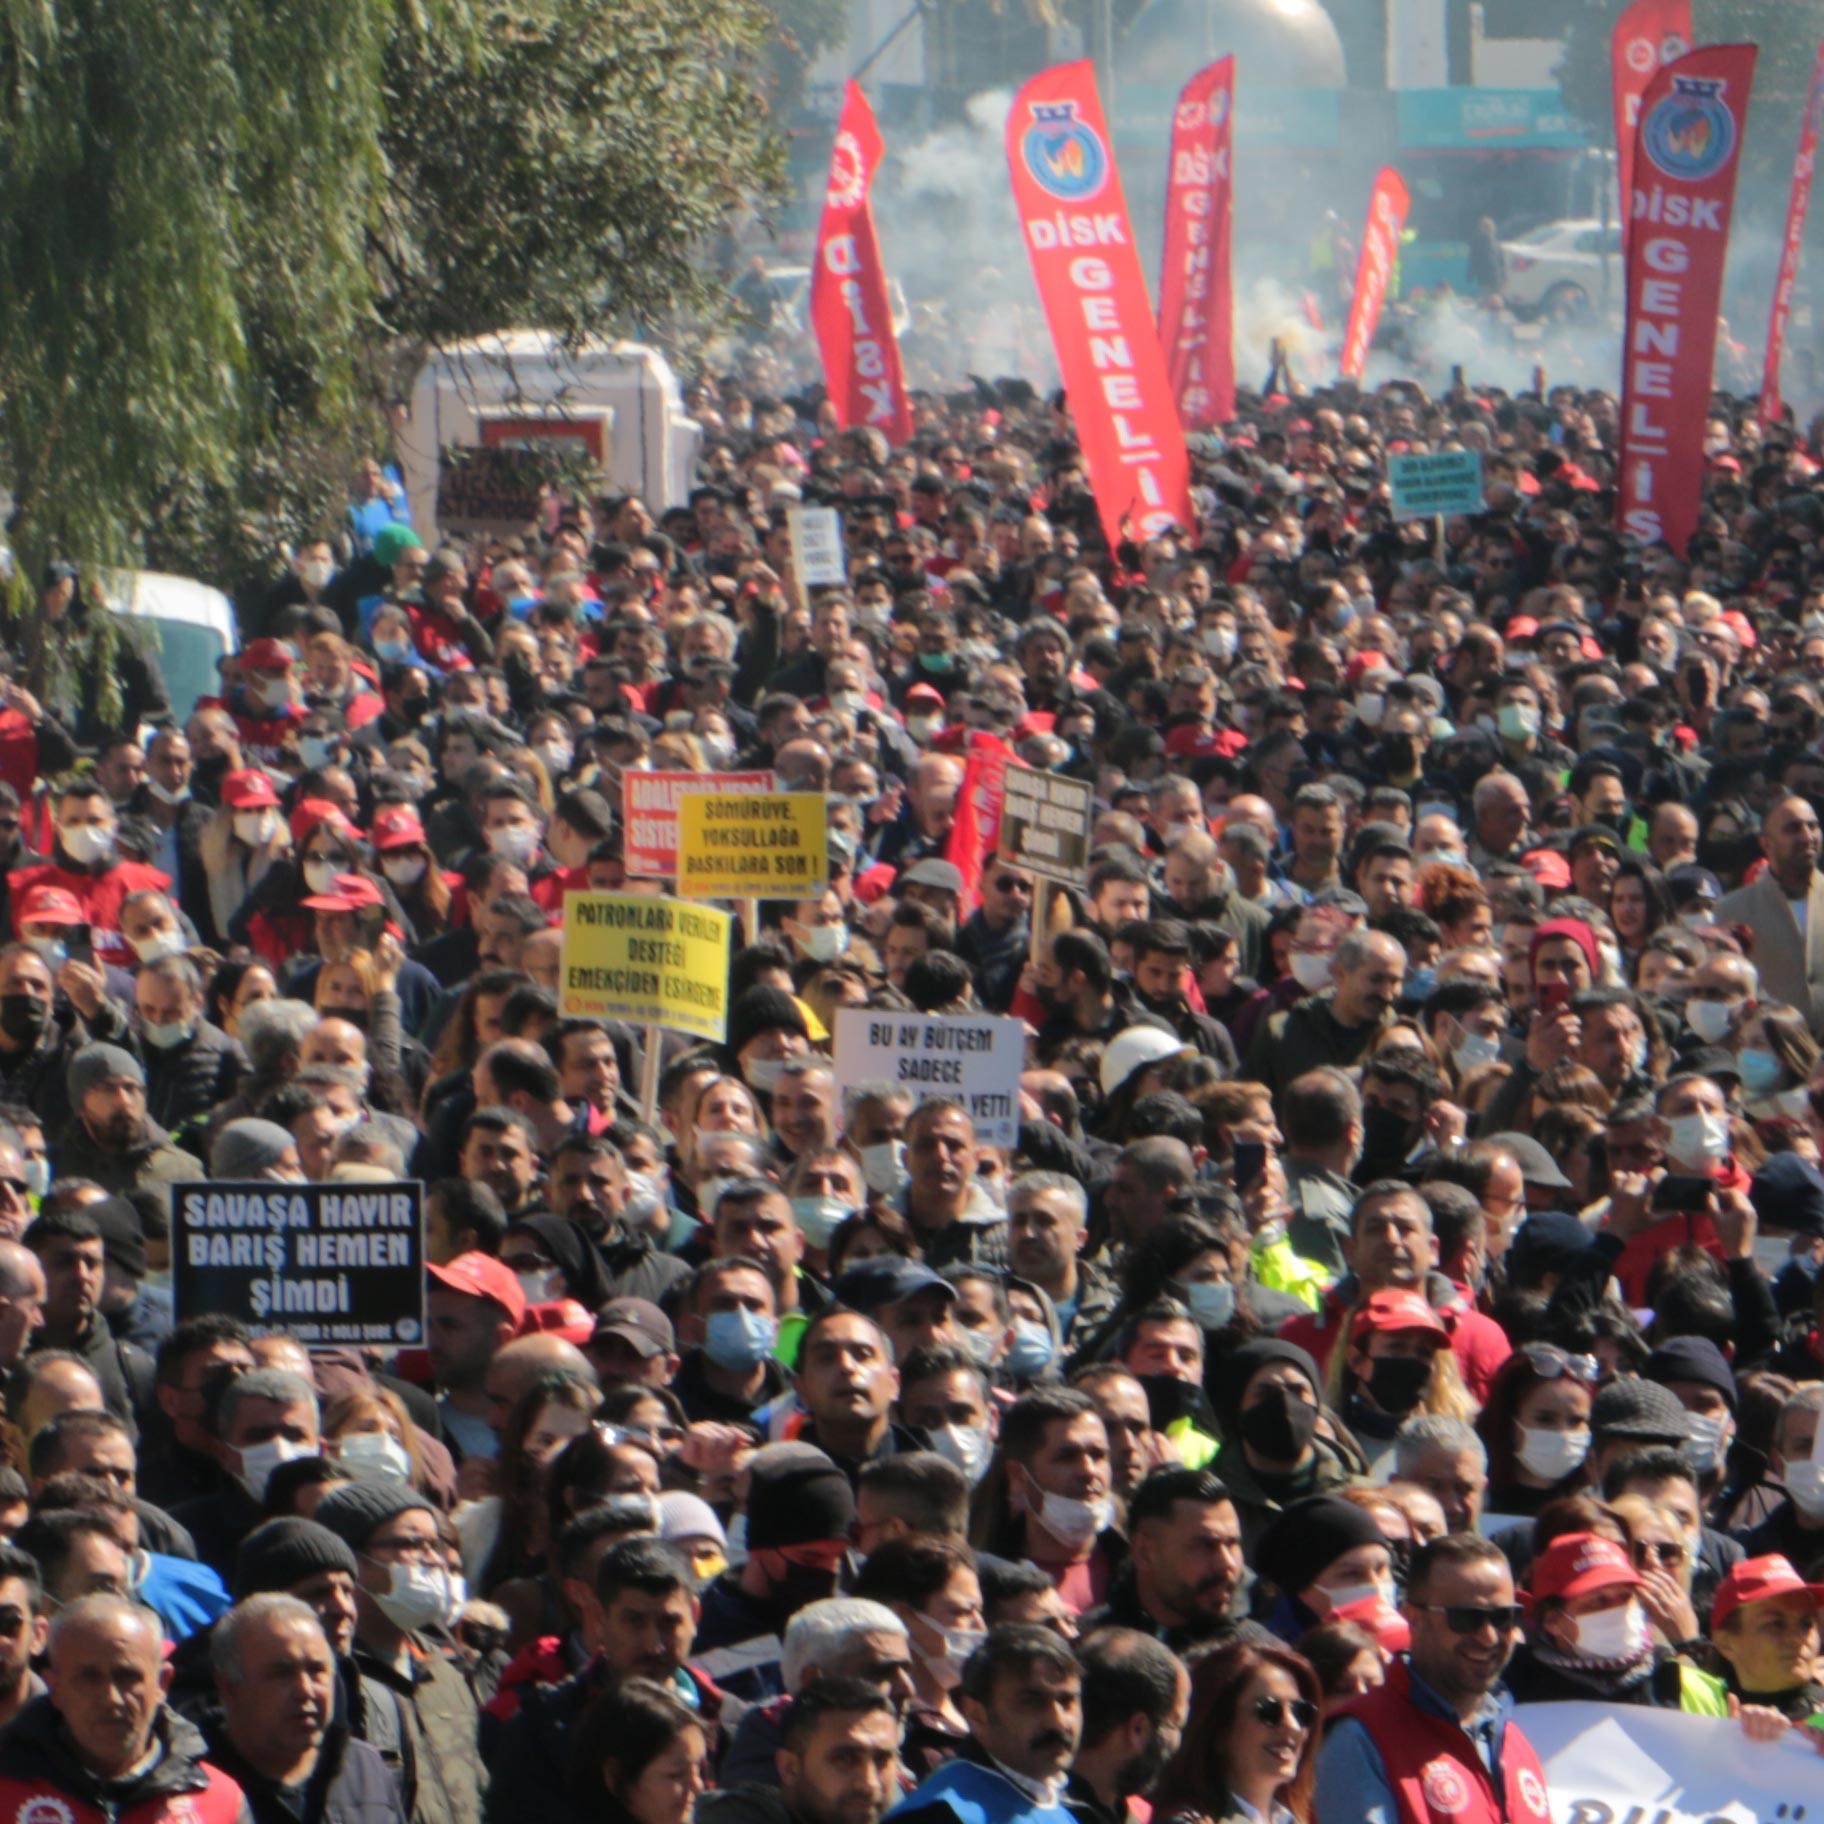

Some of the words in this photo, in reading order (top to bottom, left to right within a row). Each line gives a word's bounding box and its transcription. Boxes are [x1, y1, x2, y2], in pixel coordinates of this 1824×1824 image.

[1027, 209, 1128, 251] DİSK
[576, 902, 674, 931] PATRONLARA
[869, 1022, 893, 1047] BU
[898, 1024, 920, 1048] AY
[897, 1056, 963, 1085] SADECE
[183, 1192, 272, 1234] SAVAŞA
[318, 1193, 413, 1228] HAYIR
[187, 1231, 287, 1273] BARIŞ
[296, 1232, 411, 1267] HEMEN
[250, 1272, 350, 1318] ŞİMDİ
